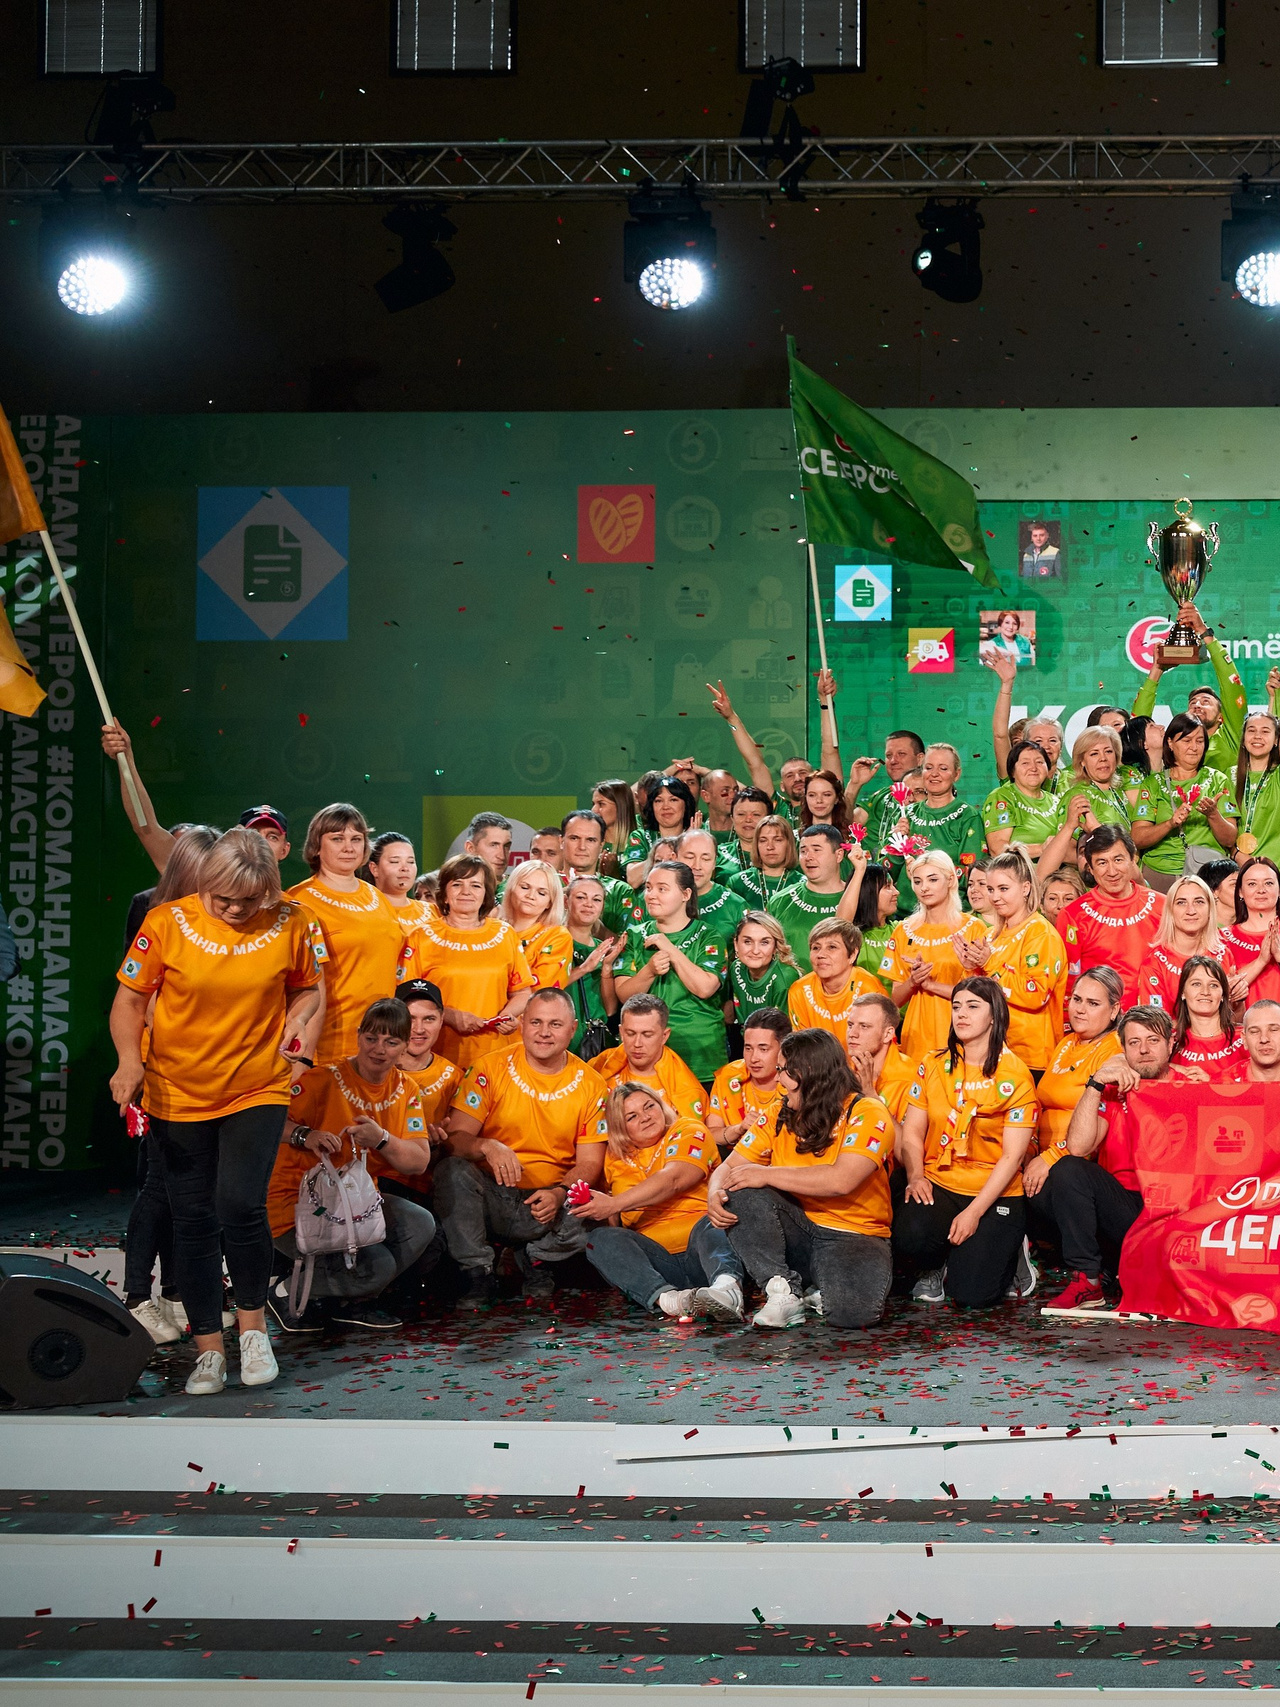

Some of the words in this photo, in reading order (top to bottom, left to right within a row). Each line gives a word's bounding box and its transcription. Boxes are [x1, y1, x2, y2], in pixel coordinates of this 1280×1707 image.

[928, 803, 968, 827] МАСТЕРОВ
[307, 887, 363, 912] КОМАНДА
[1080, 901, 1124, 926] КОМАНДА
[171, 906, 228, 955] КОМАНДА
[233, 905, 292, 956] МАСТЕРОВ
[421, 923, 468, 952] КОМАНДА
[472, 920, 510, 952] МАСТЕРОВ
[37, 746, 74, 1171] #КОМАНДАМАСТЕРО
